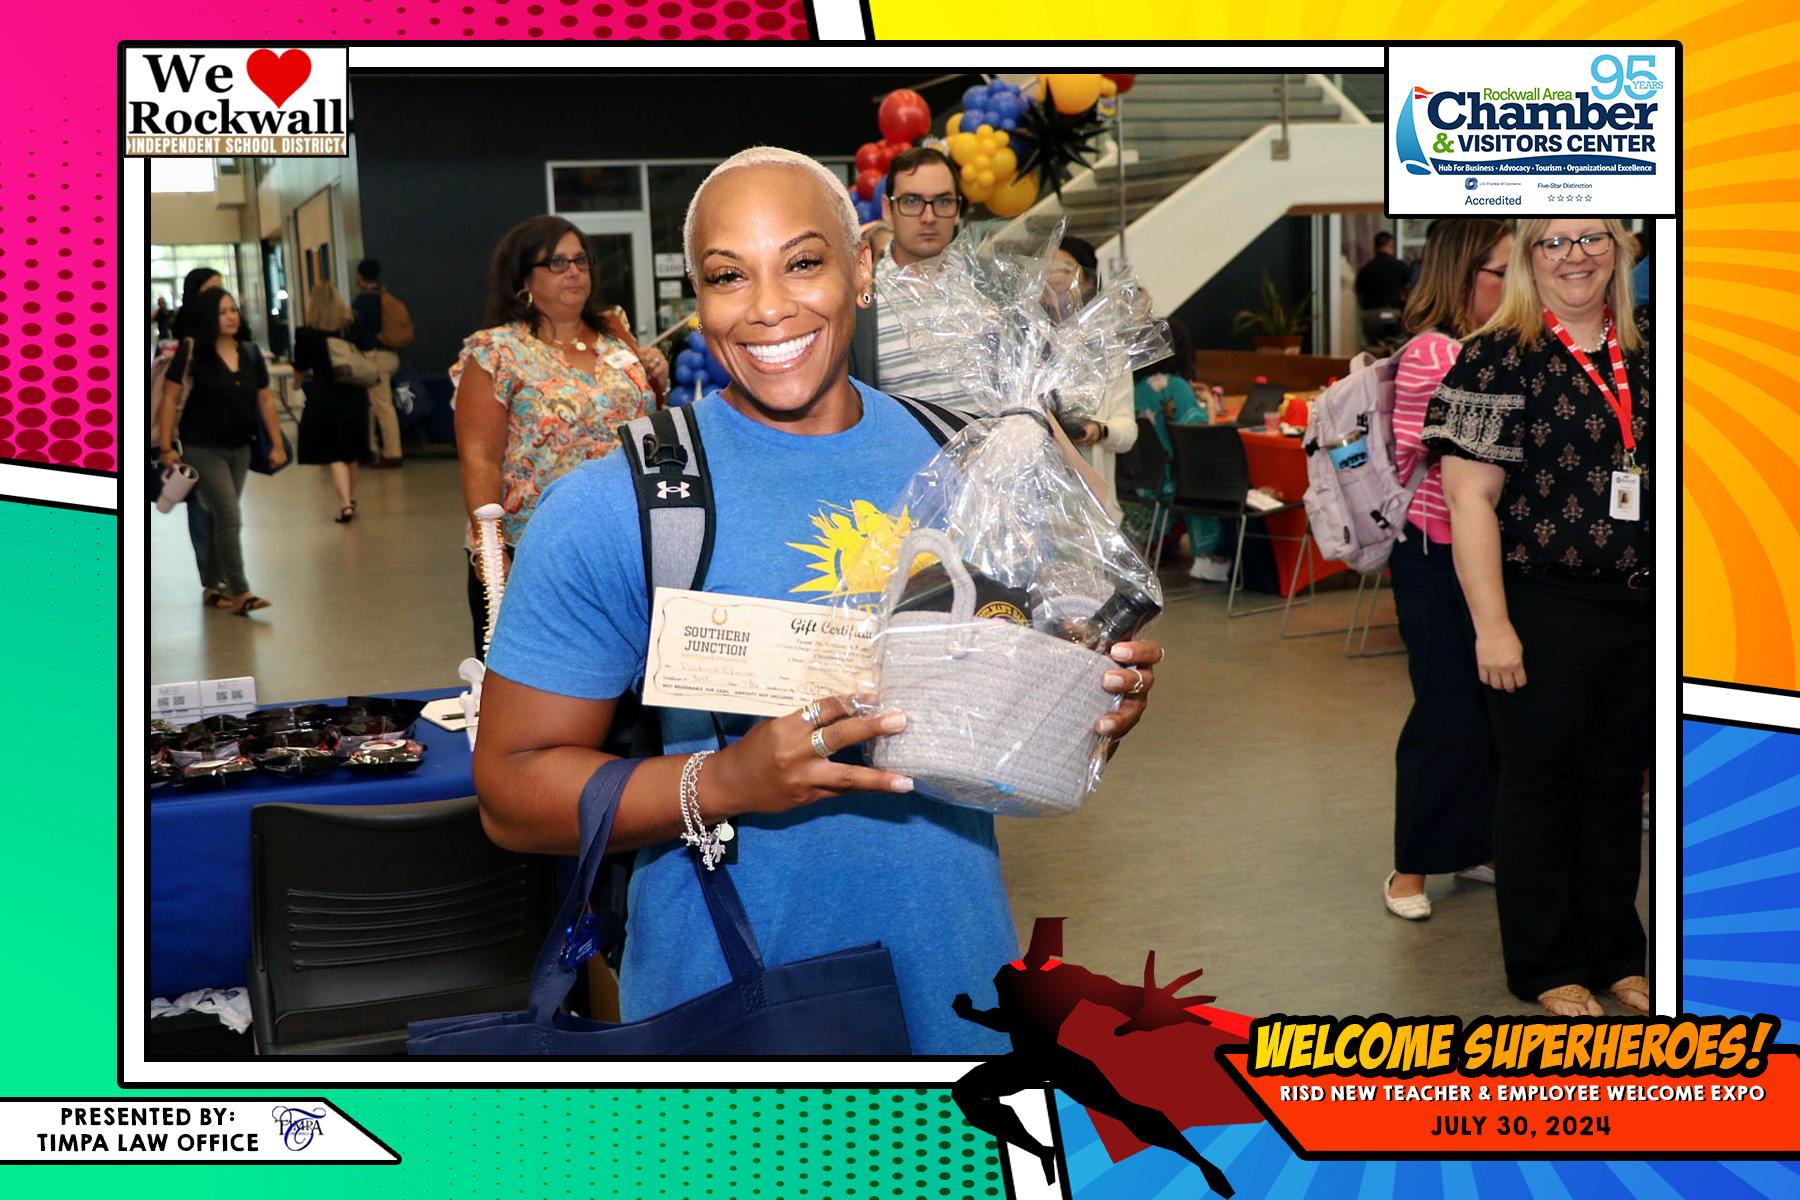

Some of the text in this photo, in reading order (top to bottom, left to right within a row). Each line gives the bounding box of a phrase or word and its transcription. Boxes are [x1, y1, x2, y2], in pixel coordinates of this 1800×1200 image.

[684, 625, 751, 643] SOUTHERN
[791, 618, 817, 635] Gift
[684, 639, 748, 657] JUNCTION
